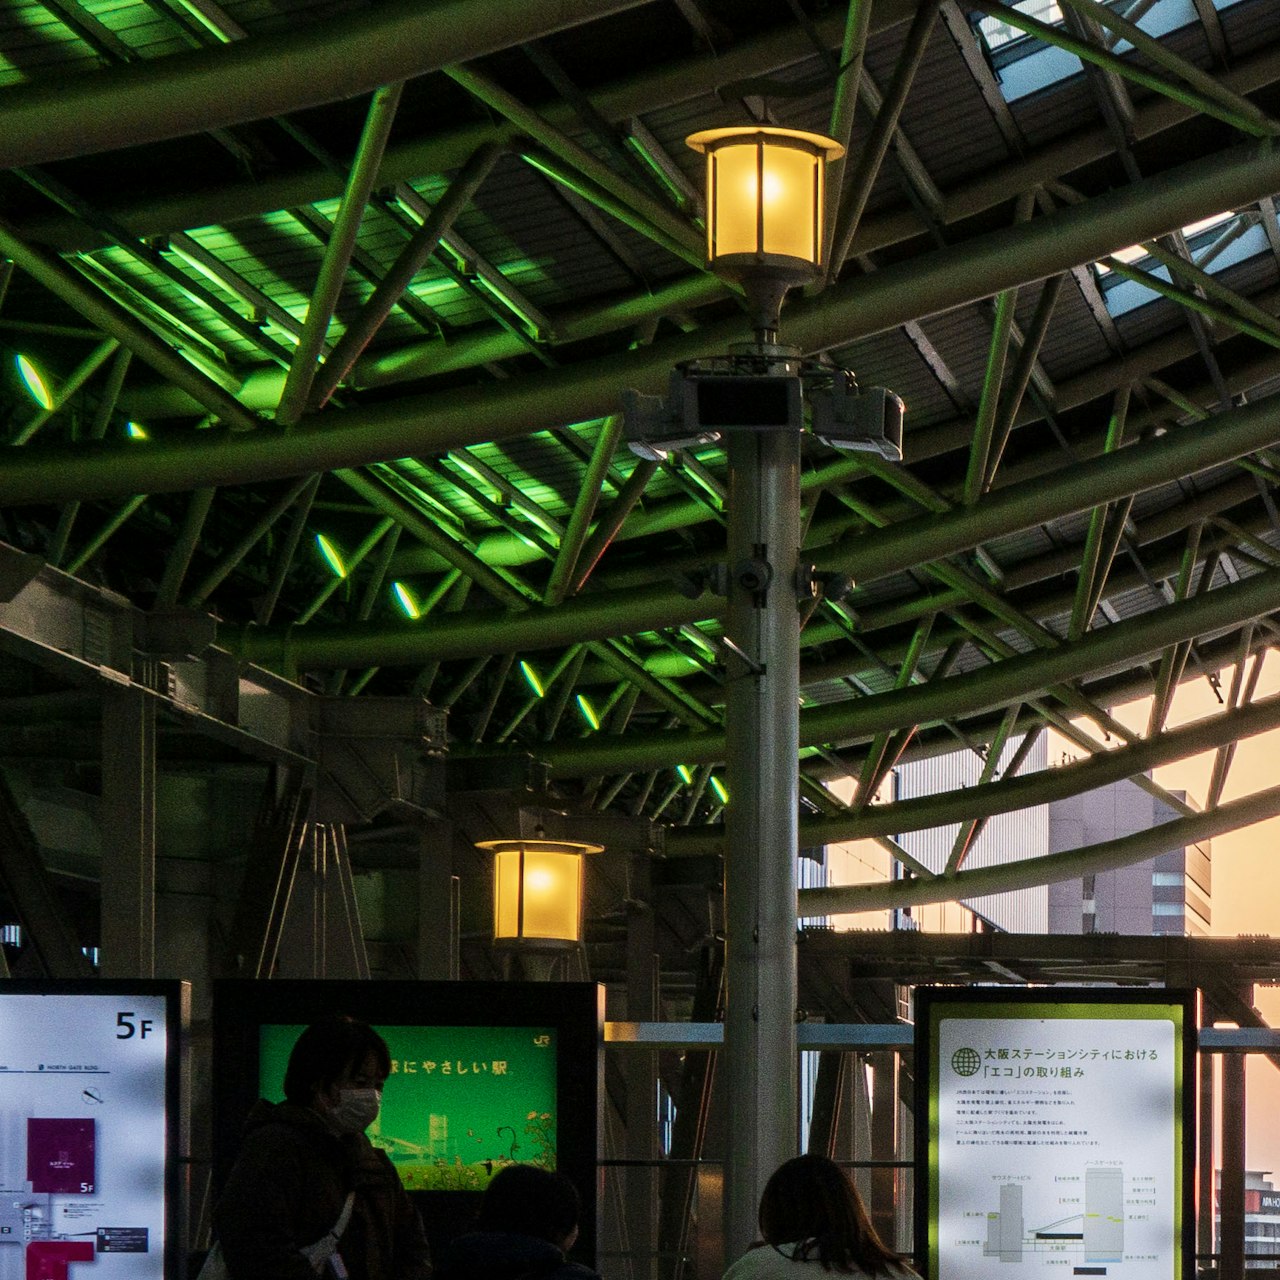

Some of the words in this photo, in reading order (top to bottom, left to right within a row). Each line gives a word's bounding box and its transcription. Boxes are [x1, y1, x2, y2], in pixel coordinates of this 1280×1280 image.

[116, 1012, 153, 1040] 5F
[534, 1034, 550, 1046] JR
[984, 1048, 1158, 1061] 大阪ステーションシティにおける
[983, 1065, 1085, 1079] 「エコ」の取り組み
[80, 1182, 94, 1193] 5F
